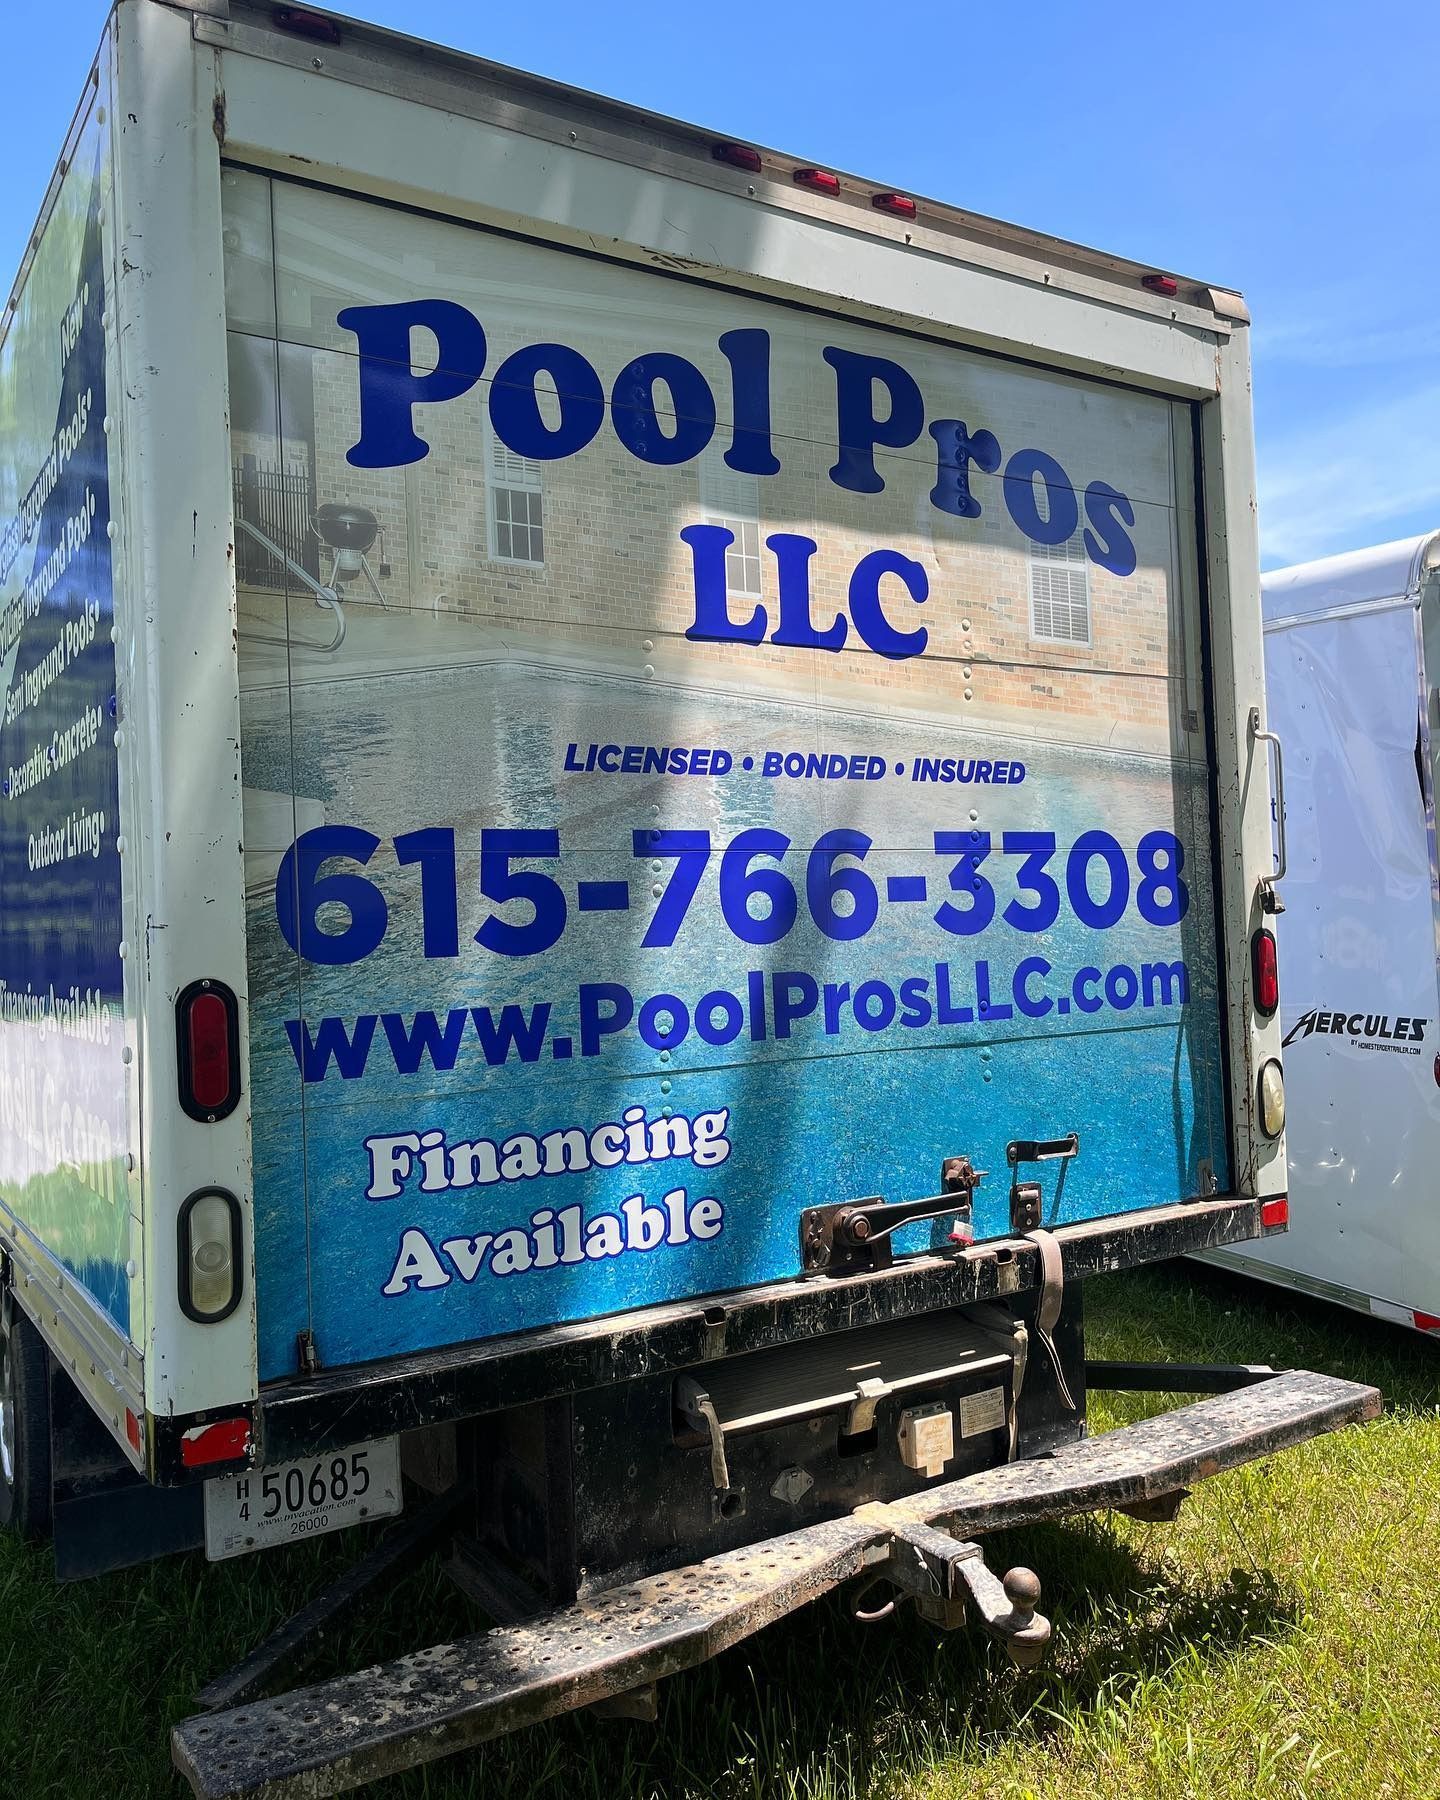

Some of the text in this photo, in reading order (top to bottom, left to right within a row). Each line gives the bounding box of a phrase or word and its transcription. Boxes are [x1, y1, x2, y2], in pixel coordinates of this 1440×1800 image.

[62, 290, 83, 368] New
[19, 440, 58, 543] Inground
[59, 392, 88, 473] Pools
[337, 298, 1136, 577] Pool Pros
[26, 527, 65, 619] Inground
[67, 486, 91, 562] Pool
[680, 524, 930, 661] LLC
[6, 671, 24, 724] Semi
[24, 629, 64, 706] Inground
[67, 599, 95, 665] Pools
[9, 704, 97, 800] Decorative Concrete
[564, 743, 1026, 784] LICENSED BONDED INSURED
[28, 807, 100, 871] Outdoor Living
[275, 824, 1190, 965] 615-766-3308
[0, 979, 111, 1045] Financing Available
[284, 956, 1190, 1083] www.PoolProsLLC.com
[1282, 1008, 1427, 1048] HERCULES
[362, 1105, 732, 1201] Financing
[381, 1188, 727, 1297] Available
[236, 1479, 250, 1500] H
[239, 1503, 250, 1521] 4
[262, 1452, 370, 1518] 50685
[290, 1515, 329, 1535] 26000
